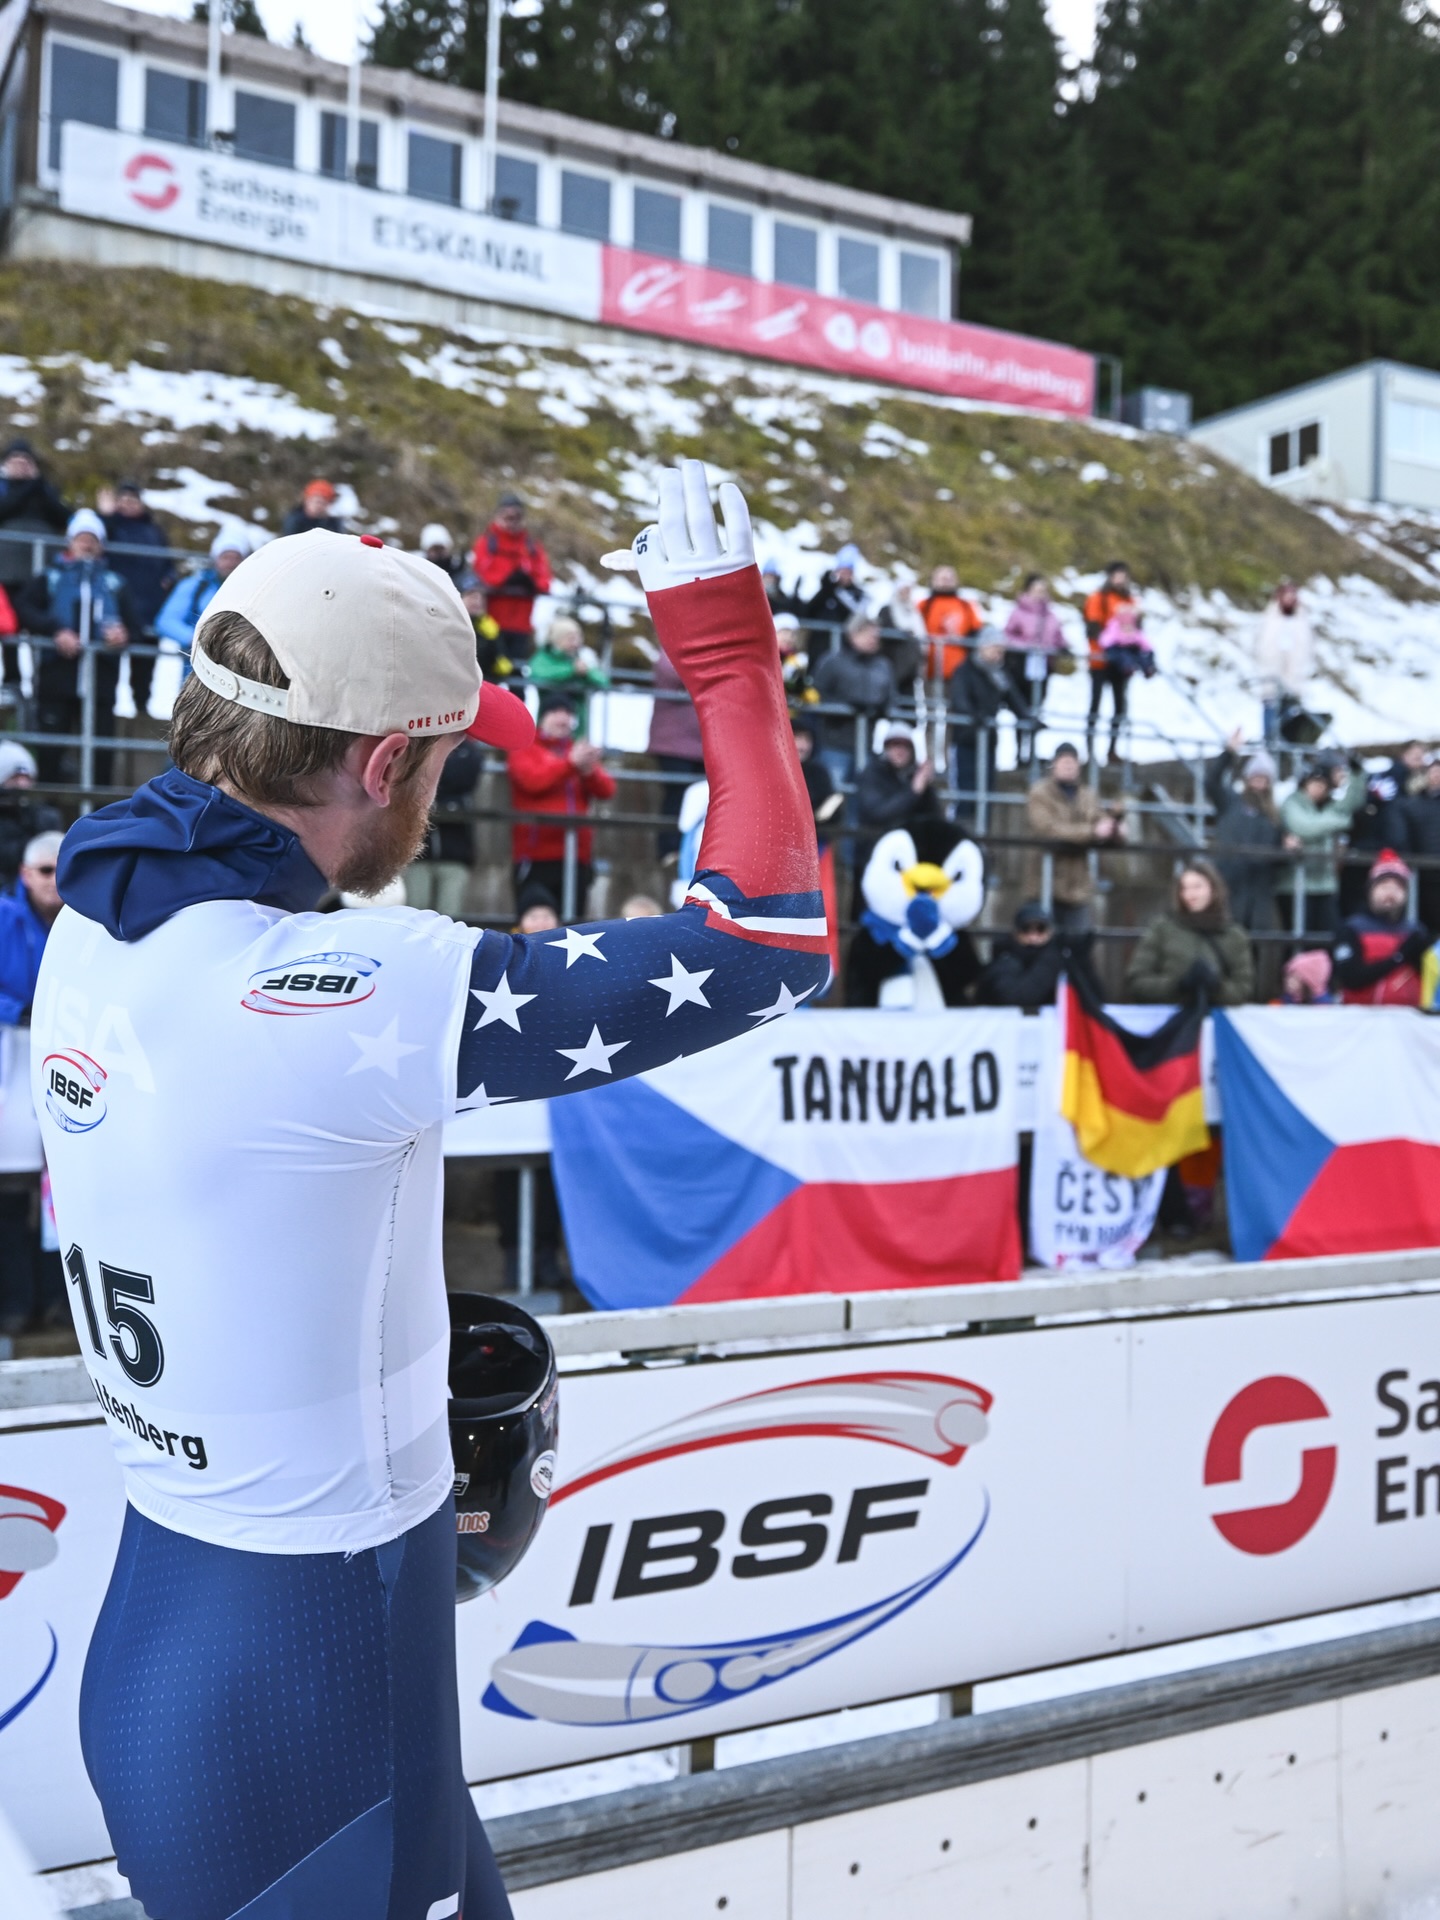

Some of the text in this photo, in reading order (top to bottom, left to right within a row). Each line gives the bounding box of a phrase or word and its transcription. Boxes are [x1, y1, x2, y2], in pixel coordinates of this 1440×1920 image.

[198, 198, 308, 242] Energie
[373, 214, 548, 280] EISKANAL
[408, 717, 432, 730] ONE
[261, 973, 358, 994] IBSF
[50, 1068, 94, 1109] IBSF
[64, 1243, 165, 1388] 15
[90, 1375, 208, 1470] ltenberg
[1376, 1369, 1440, 1438] Sa
[1376, 1455, 1440, 1525] En
[567, 1478, 931, 1608] IBSF
